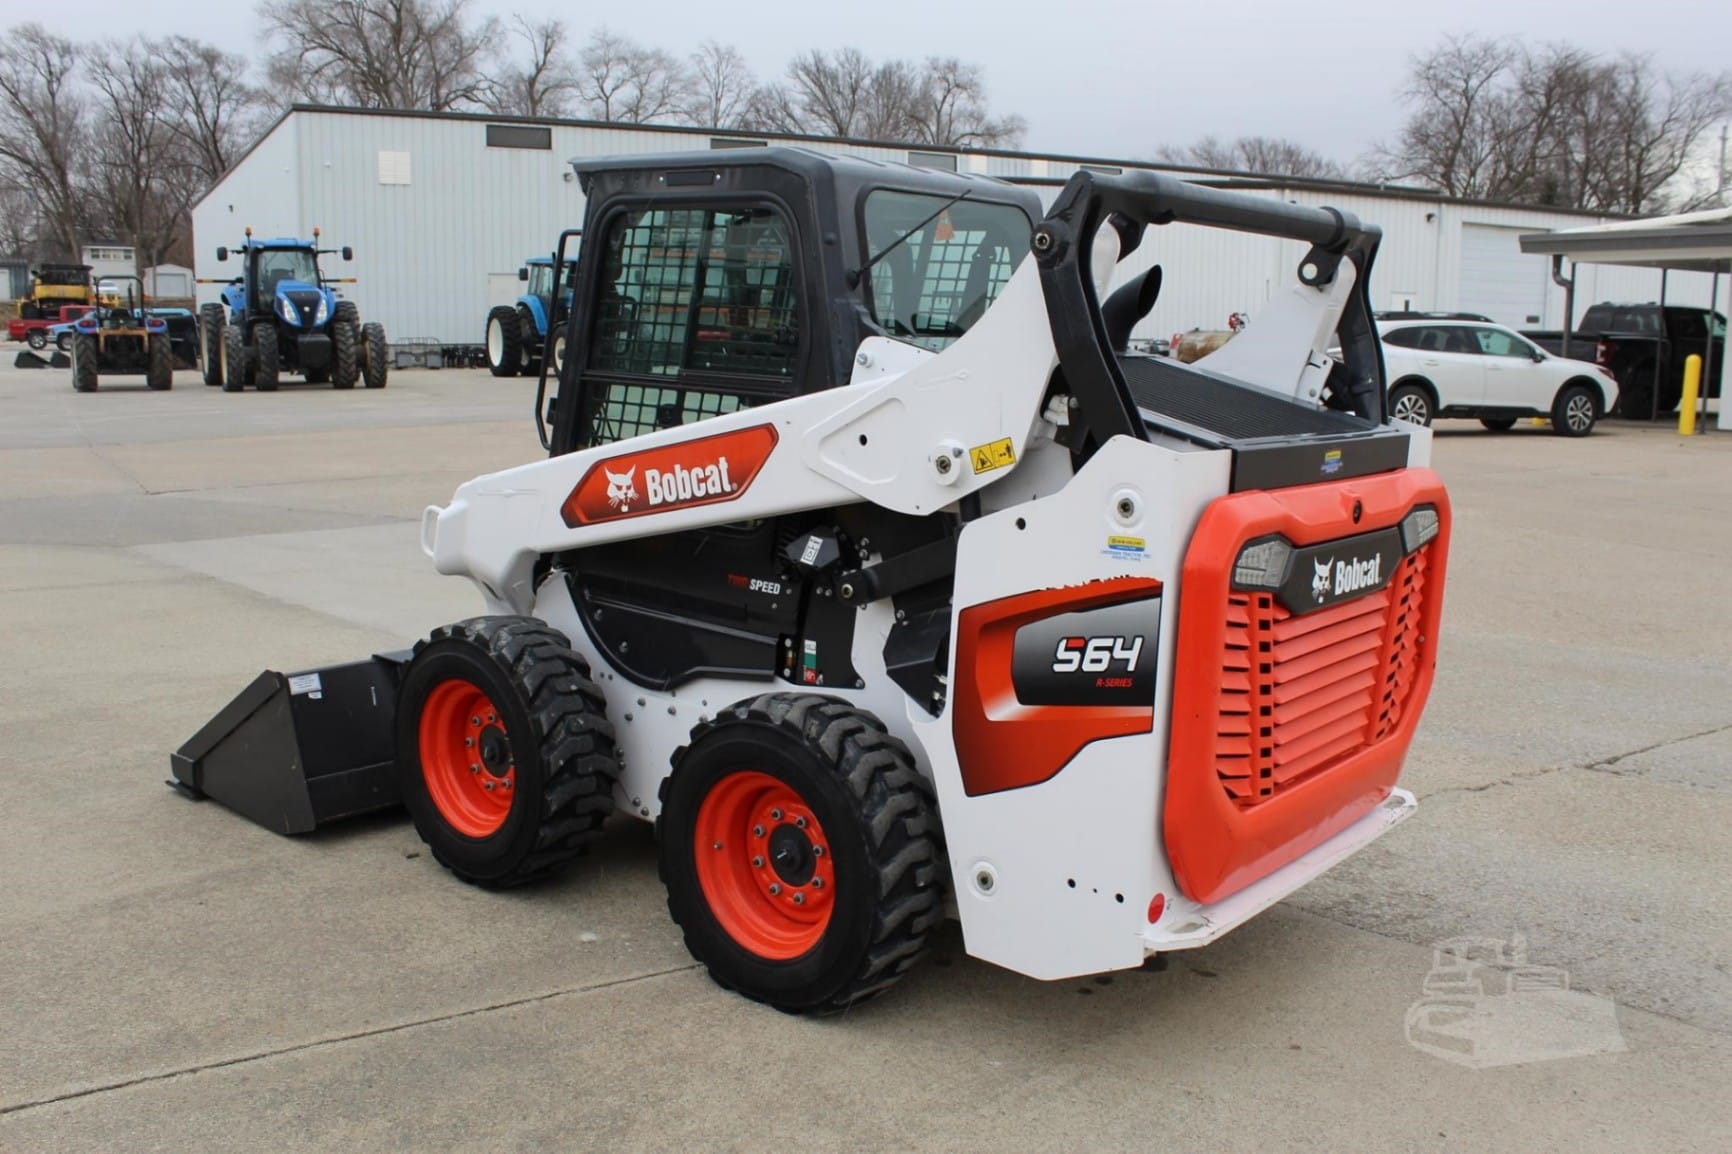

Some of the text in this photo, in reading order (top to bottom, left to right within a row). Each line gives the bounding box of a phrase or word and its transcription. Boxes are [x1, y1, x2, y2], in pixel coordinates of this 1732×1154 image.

[645, 456, 731, 505] Bobcat
[749, 578, 781, 595] SPEED
[1334, 552, 1381, 596] Bobcat
[1052, 637, 1143, 672] S64
[1095, 677, 1134, 689] R-SERIES
